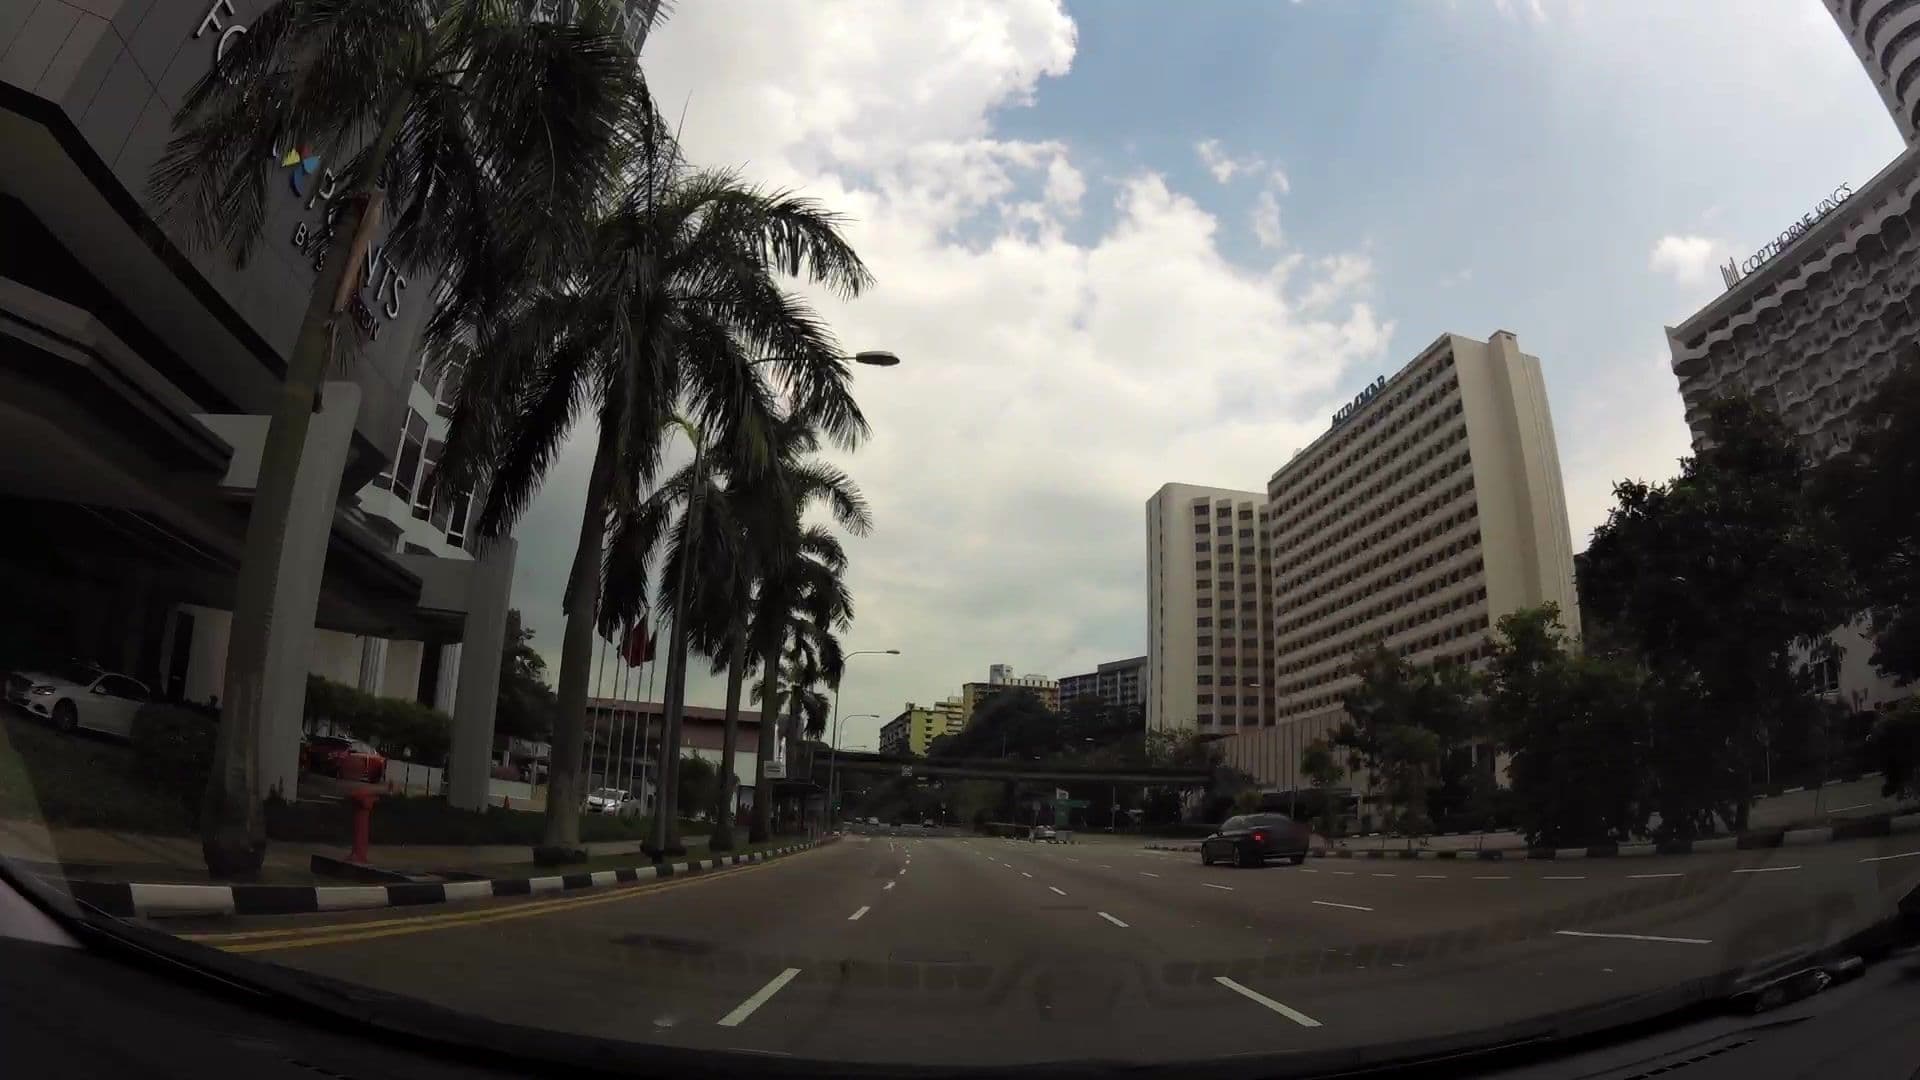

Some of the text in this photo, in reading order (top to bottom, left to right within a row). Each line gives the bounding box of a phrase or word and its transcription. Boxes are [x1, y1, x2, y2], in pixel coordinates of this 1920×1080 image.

[1742, 181, 1853, 275] COPTHORNE KING'S
[1332, 374, 1387, 426] MIRAMAR
